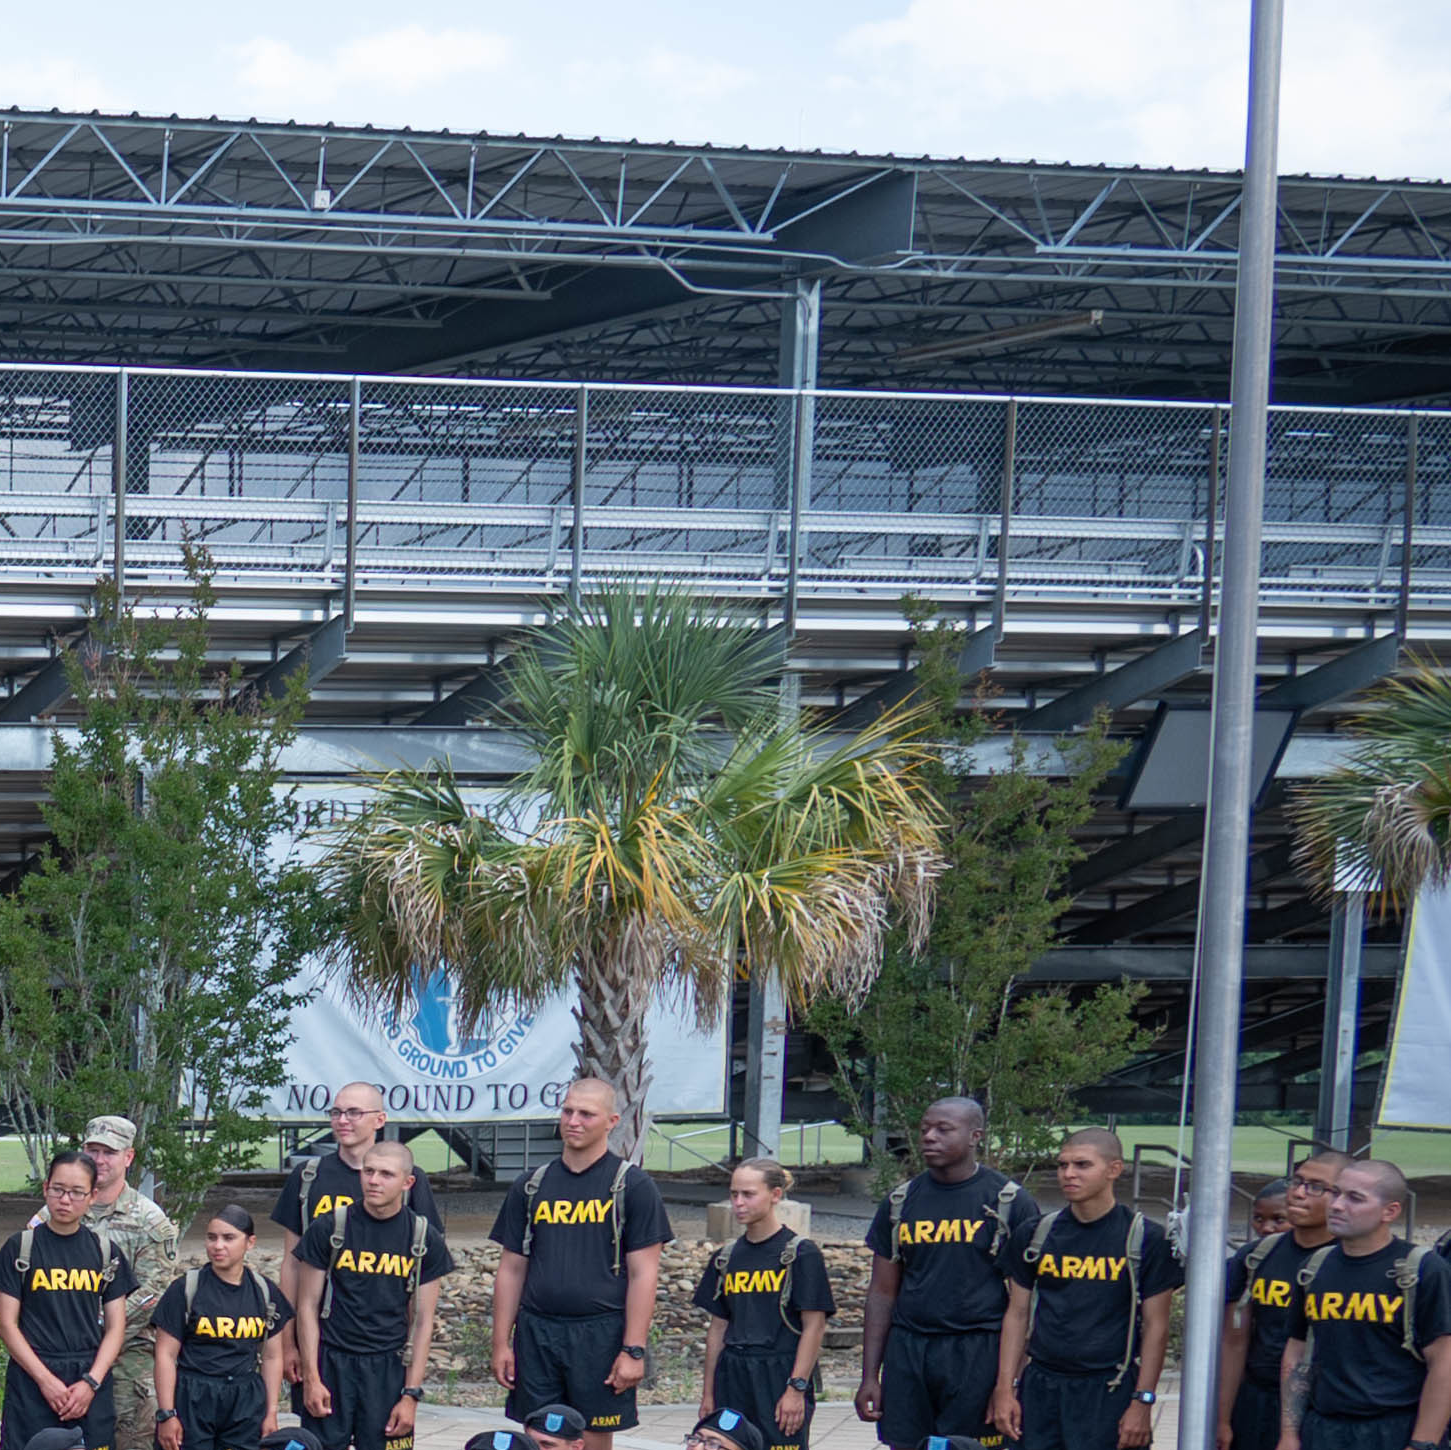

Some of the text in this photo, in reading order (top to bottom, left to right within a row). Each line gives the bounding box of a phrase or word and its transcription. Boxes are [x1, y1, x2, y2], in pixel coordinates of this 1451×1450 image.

[398, 1014, 536, 1079] GROUND TO GIVE
[286, 1083, 330, 1112] NO
[487, 1083, 528, 1111] TO
[533, 1199, 614, 1225] ARMY
[899, 1220, 984, 1245] ARMY
[336, 1250, 415, 1278] ARMY
[1037, 1255, 1127, 1281] ARMY
[31, 1268, 104, 1293] ARMY
[724, 1268, 786, 1296] ARMY
[1305, 1292, 1404, 1323] ARMY
[195, 1317, 266, 1339] ARMY
[592, 1415, 620, 1426] ARMY
